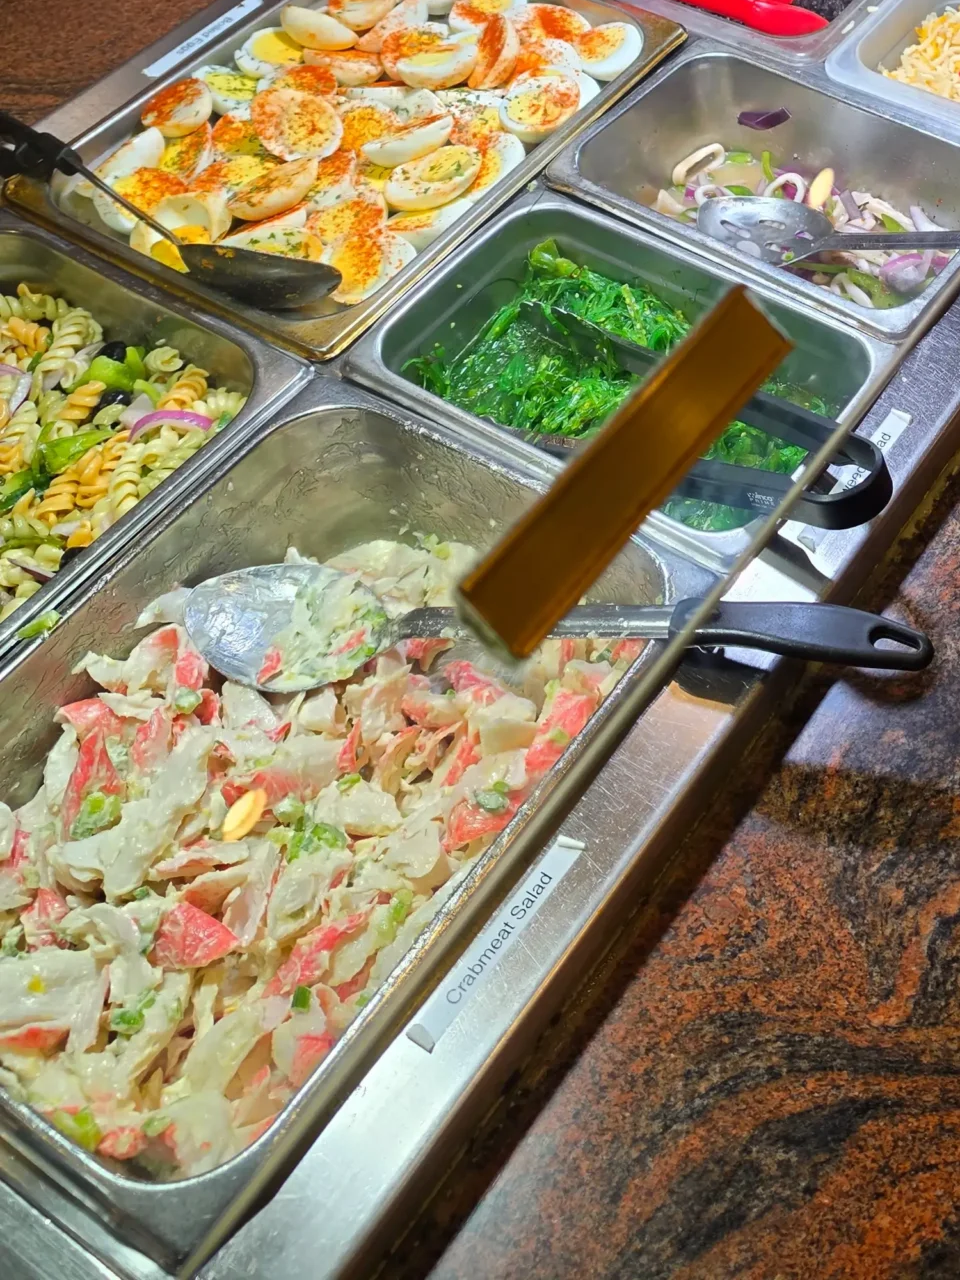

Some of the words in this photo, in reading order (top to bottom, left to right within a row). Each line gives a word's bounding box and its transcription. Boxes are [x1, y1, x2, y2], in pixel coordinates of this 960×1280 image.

[203, 16, 233, 38] Boiled
[176, 37, 203, 55] Eggs
[446, 921, 516, 1005] Crabmeat
[510, 871, 553, 920] Salad
